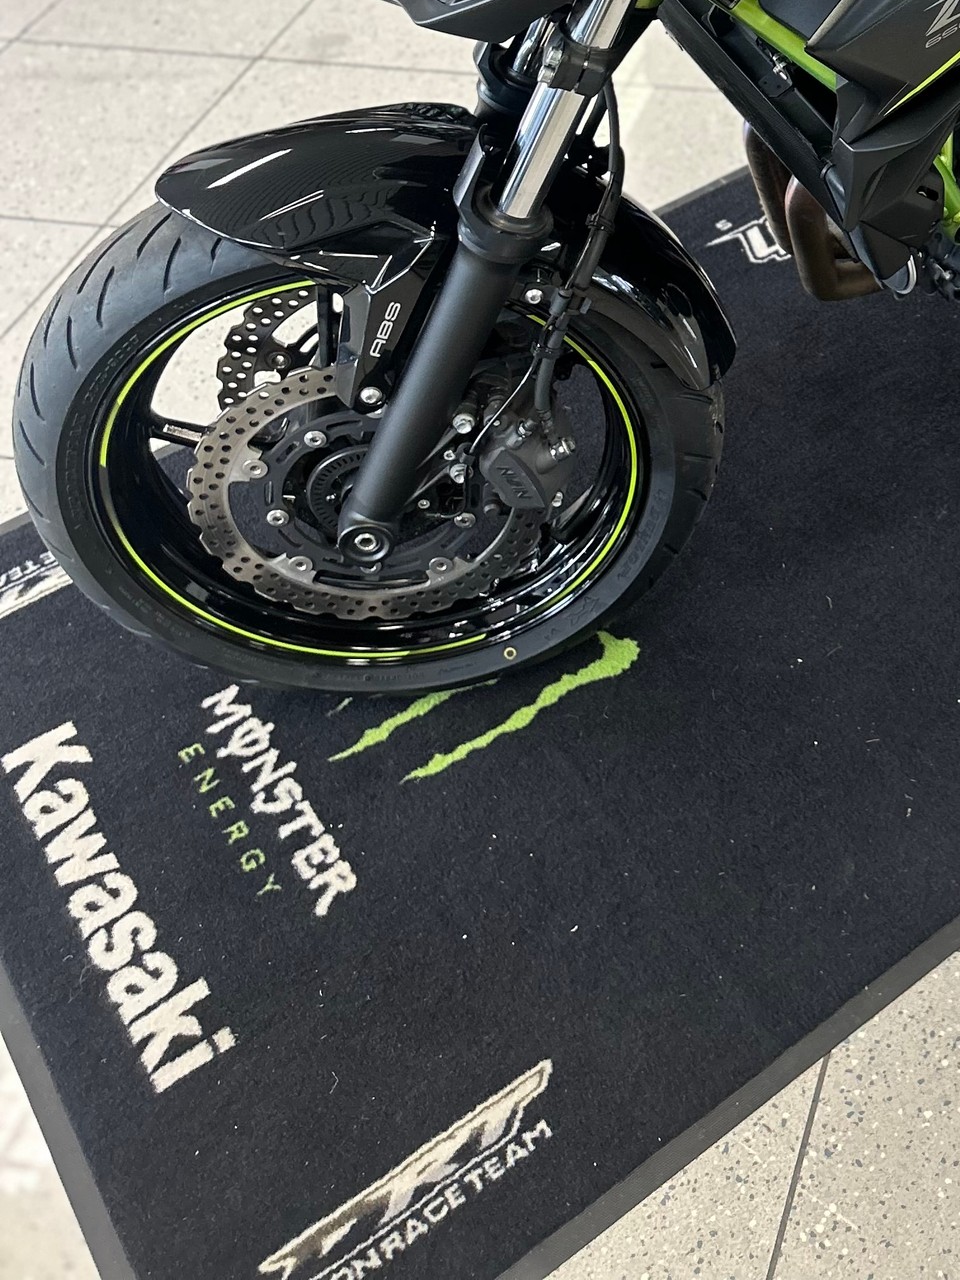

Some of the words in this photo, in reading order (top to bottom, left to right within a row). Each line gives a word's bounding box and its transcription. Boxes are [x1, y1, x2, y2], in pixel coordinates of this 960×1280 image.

[368, 301, 402, 358] ABS
[179, 742, 282, 896] ENERGY
[2, 721, 238, 1093] Kawasaki
[380, 1184, 466, 1259] RACE
[464, 1119, 553, 1193] TEAM
